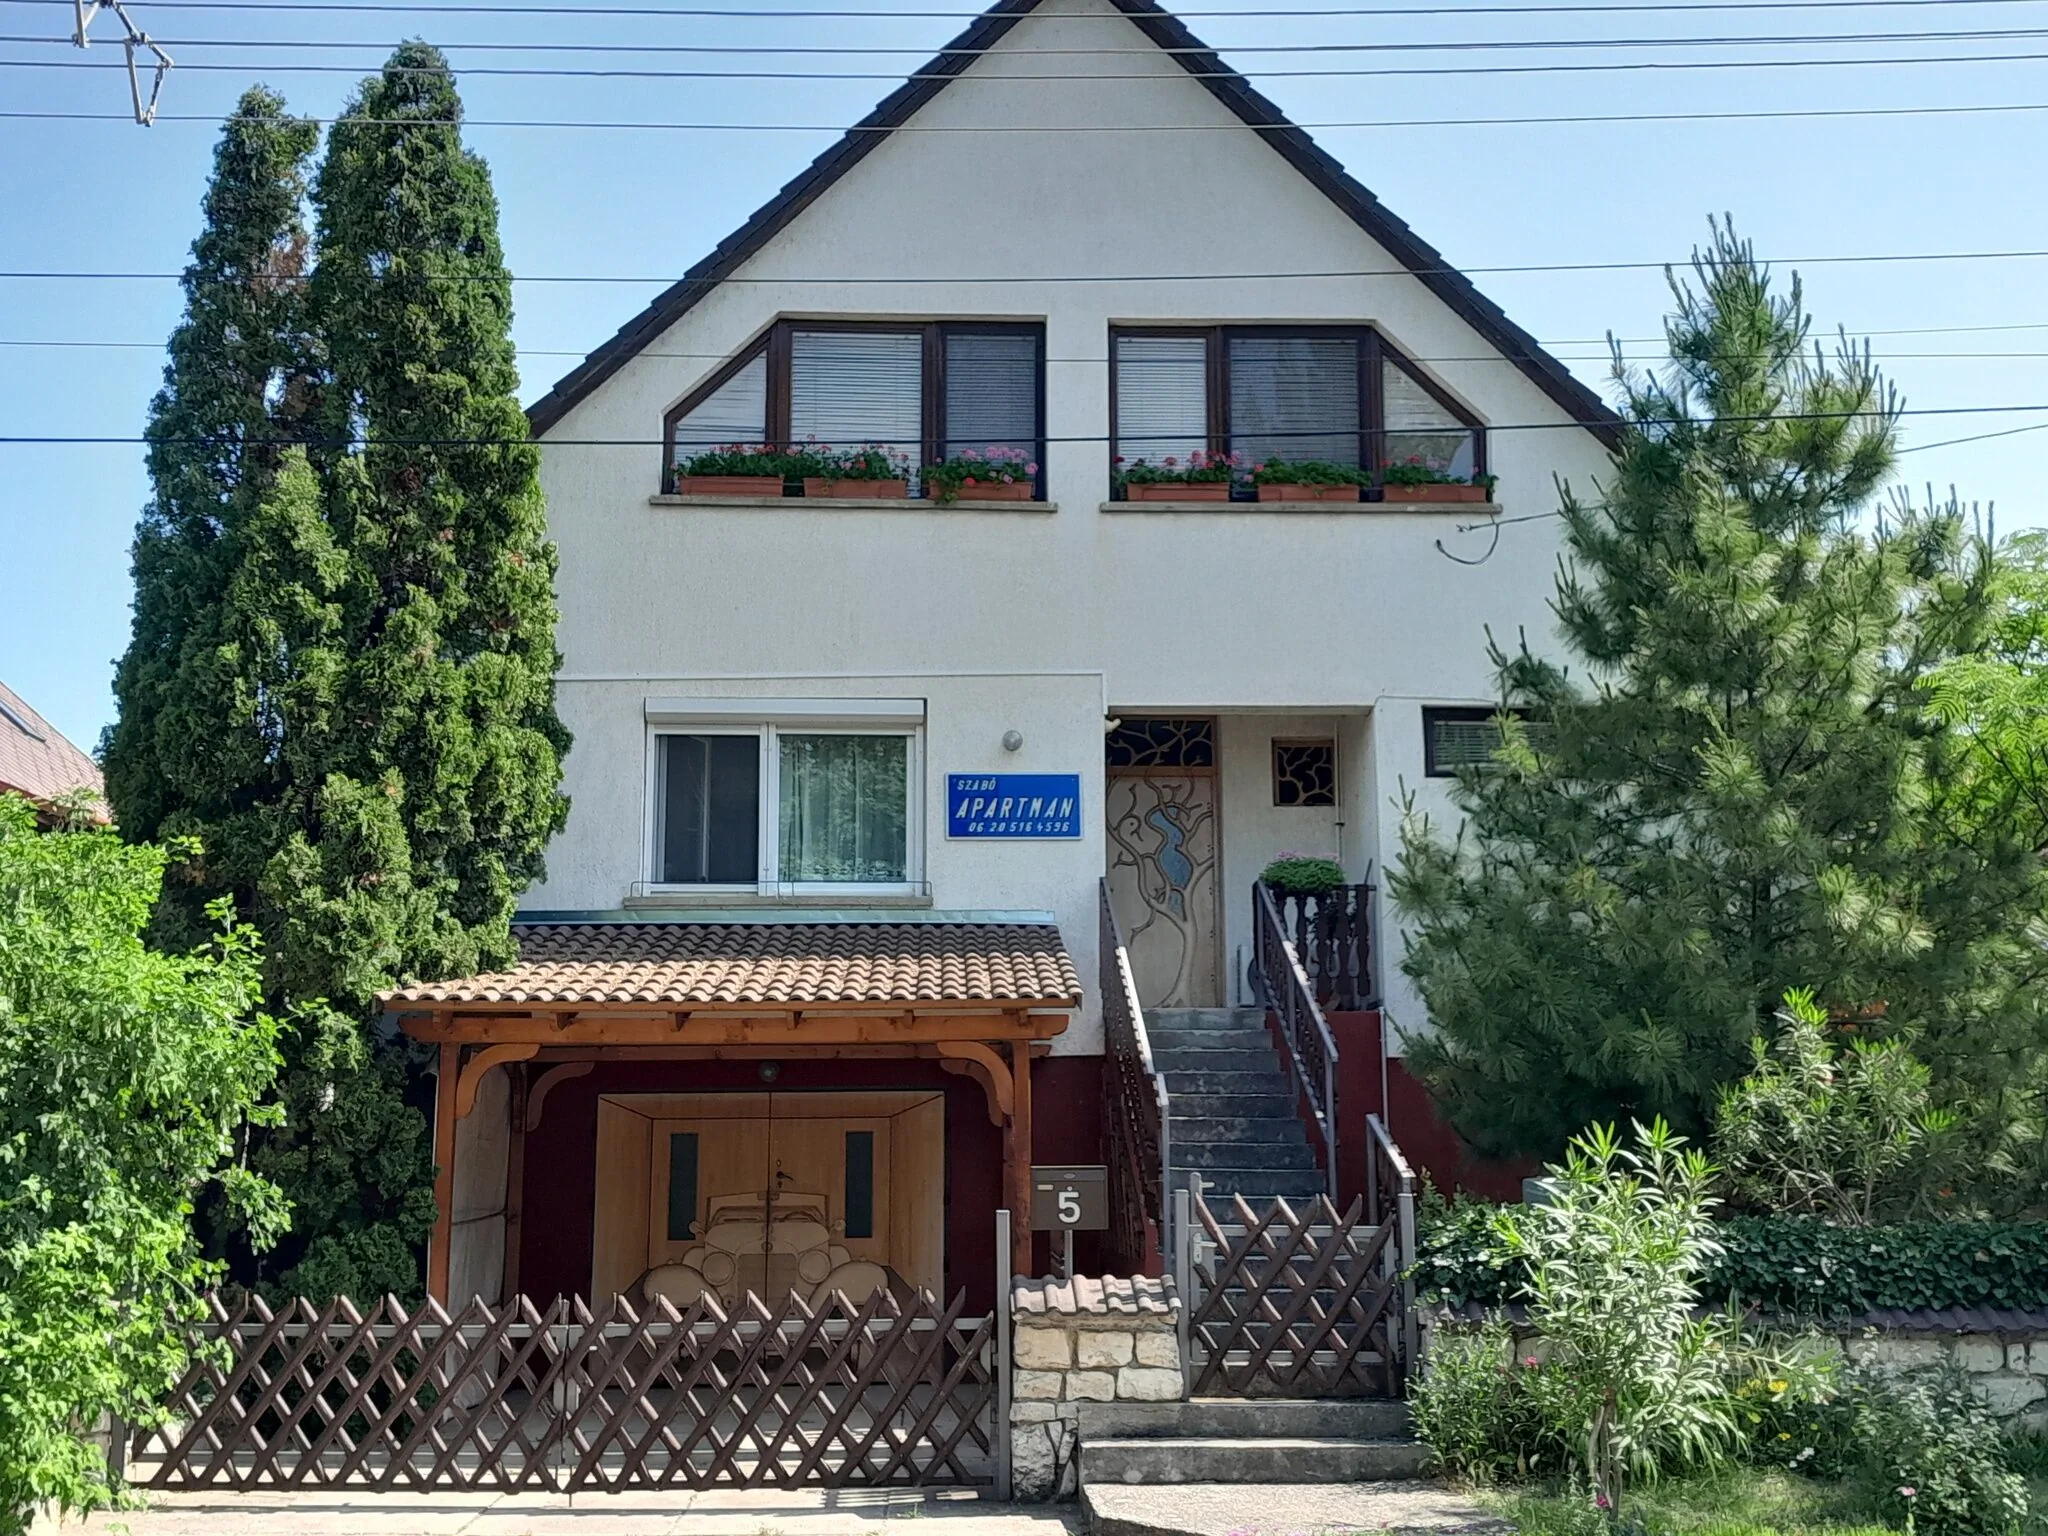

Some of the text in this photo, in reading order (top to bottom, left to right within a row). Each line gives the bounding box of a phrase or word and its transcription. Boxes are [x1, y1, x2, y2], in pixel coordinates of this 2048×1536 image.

[957, 777, 997, 790] SZABÓ
[955, 797, 1073, 818] APARTMAN
[968, 822, 1070, 832] 06 20 516 4596
[1058, 1191, 1081, 1223] 5
